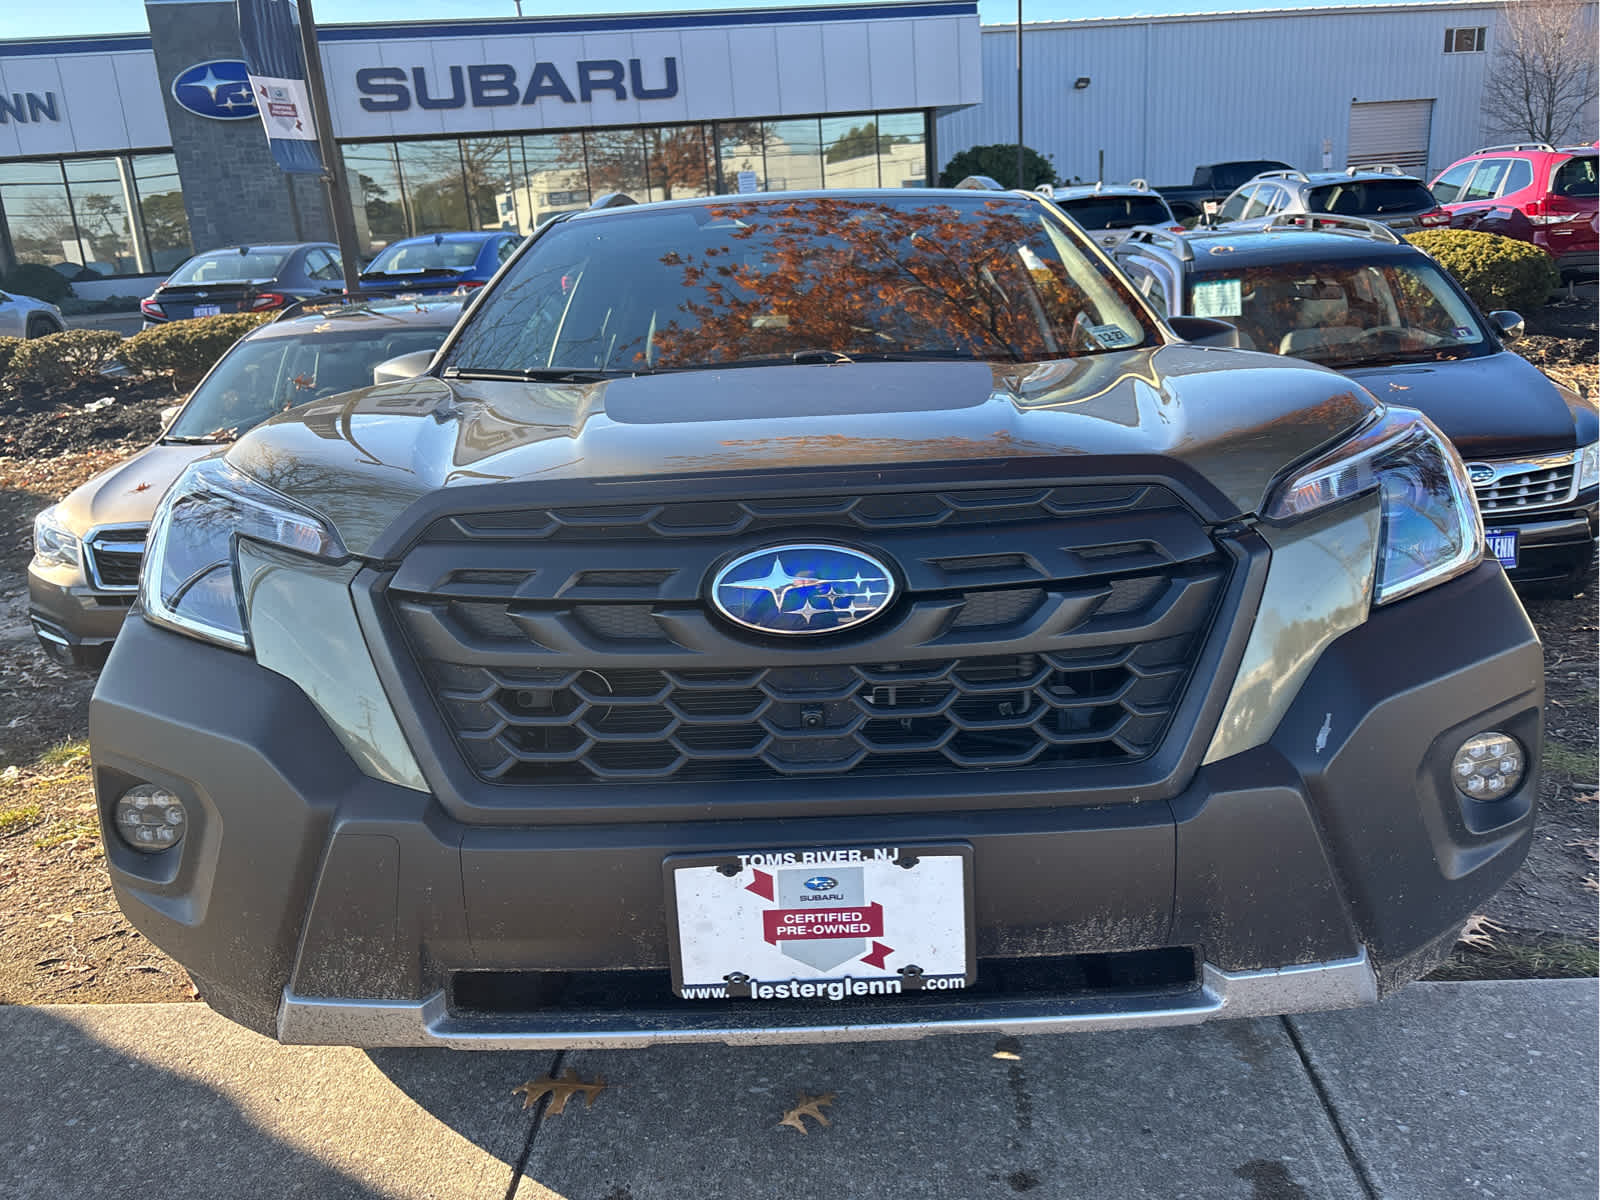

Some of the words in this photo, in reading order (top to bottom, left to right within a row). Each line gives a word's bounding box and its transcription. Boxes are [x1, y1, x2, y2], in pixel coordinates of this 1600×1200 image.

[356, 57, 678, 112] SUBARU
[737, 853, 796, 866] TOMS
[874, 848, 899, 861] NJ
[784, 912, 862, 924] CERTIFIED
[776, 923, 871, 935] PRE-OWNED
